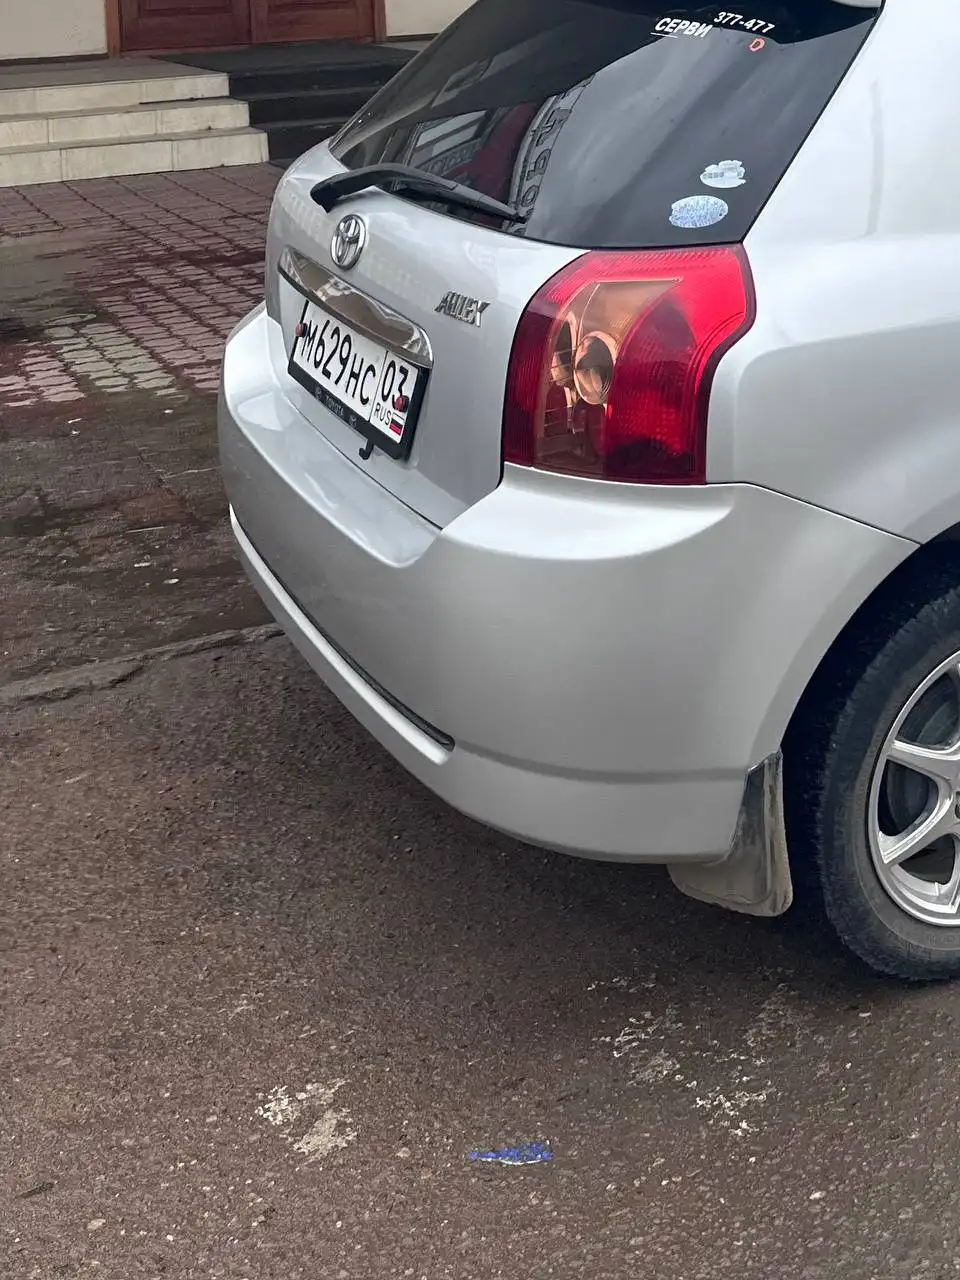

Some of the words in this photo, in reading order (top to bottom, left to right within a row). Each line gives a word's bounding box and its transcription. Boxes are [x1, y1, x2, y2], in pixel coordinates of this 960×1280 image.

[714, 11, 775, 33] 377-477
[381, 360, 409, 407] 03
[374, 403, 392, 425] RUS
